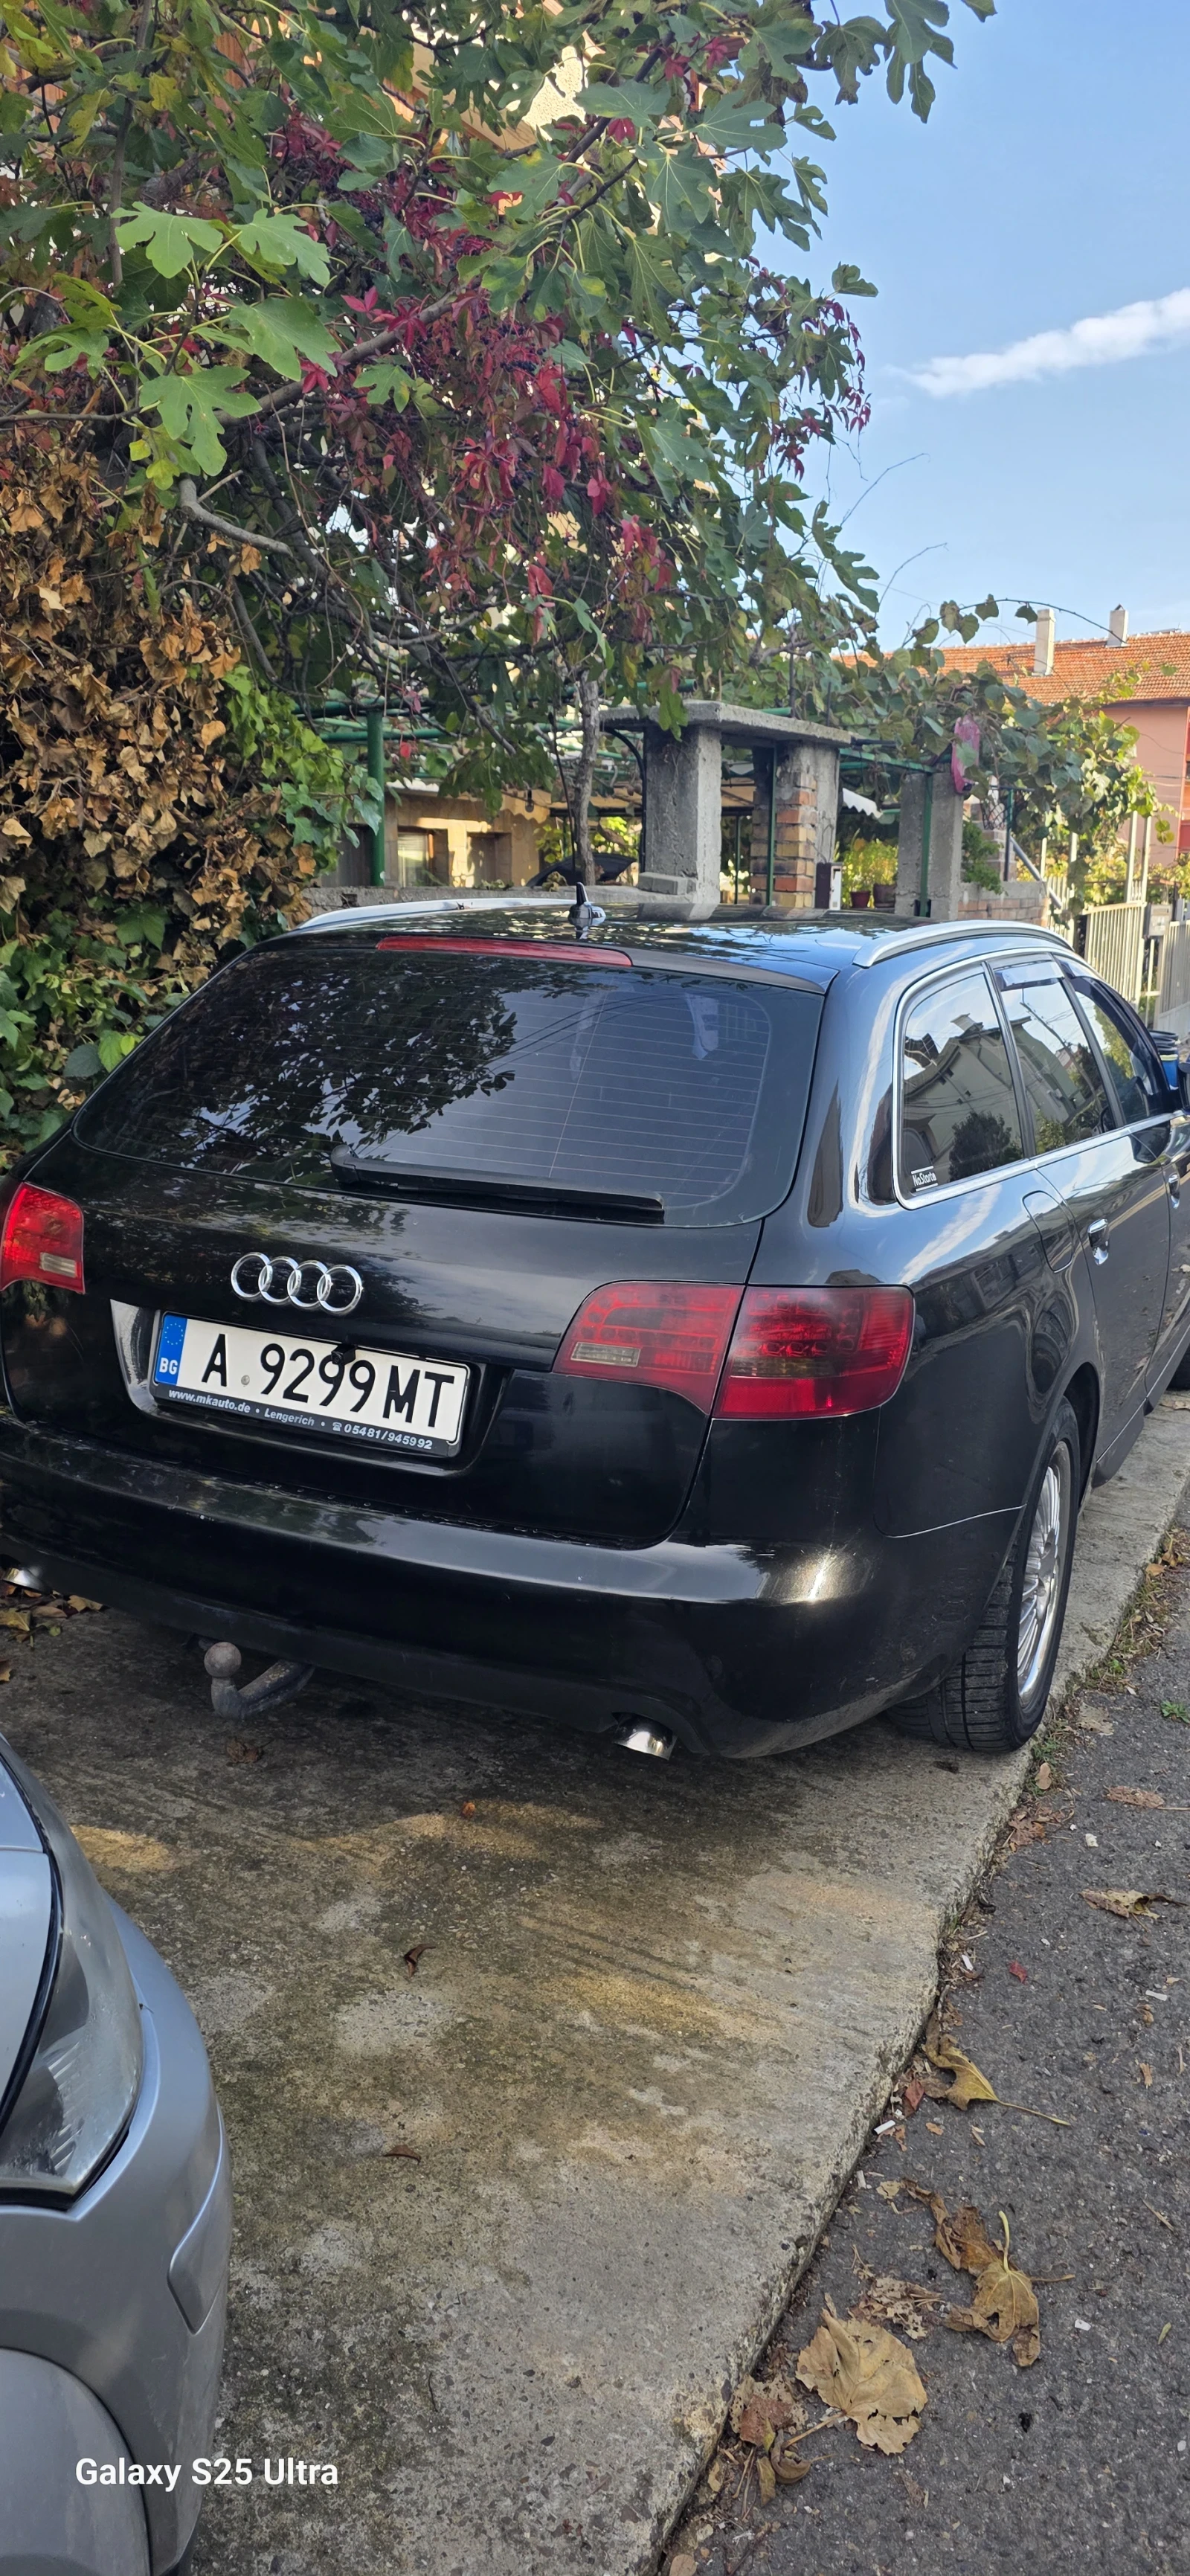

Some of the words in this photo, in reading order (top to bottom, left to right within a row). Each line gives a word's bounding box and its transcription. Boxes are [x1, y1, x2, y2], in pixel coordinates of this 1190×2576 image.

[158, 1357, 178, 1376] BG
[202, 1333, 228, 1387] A
[260, 1343, 376, 1413] 9299
[382, 1365, 455, 1428] MT
[168, 1389, 251, 1413] www.mkauto.de
[264, 1407, 315, 1427] Lengerich
[344, 1423, 433, 1450] 05481/945992
